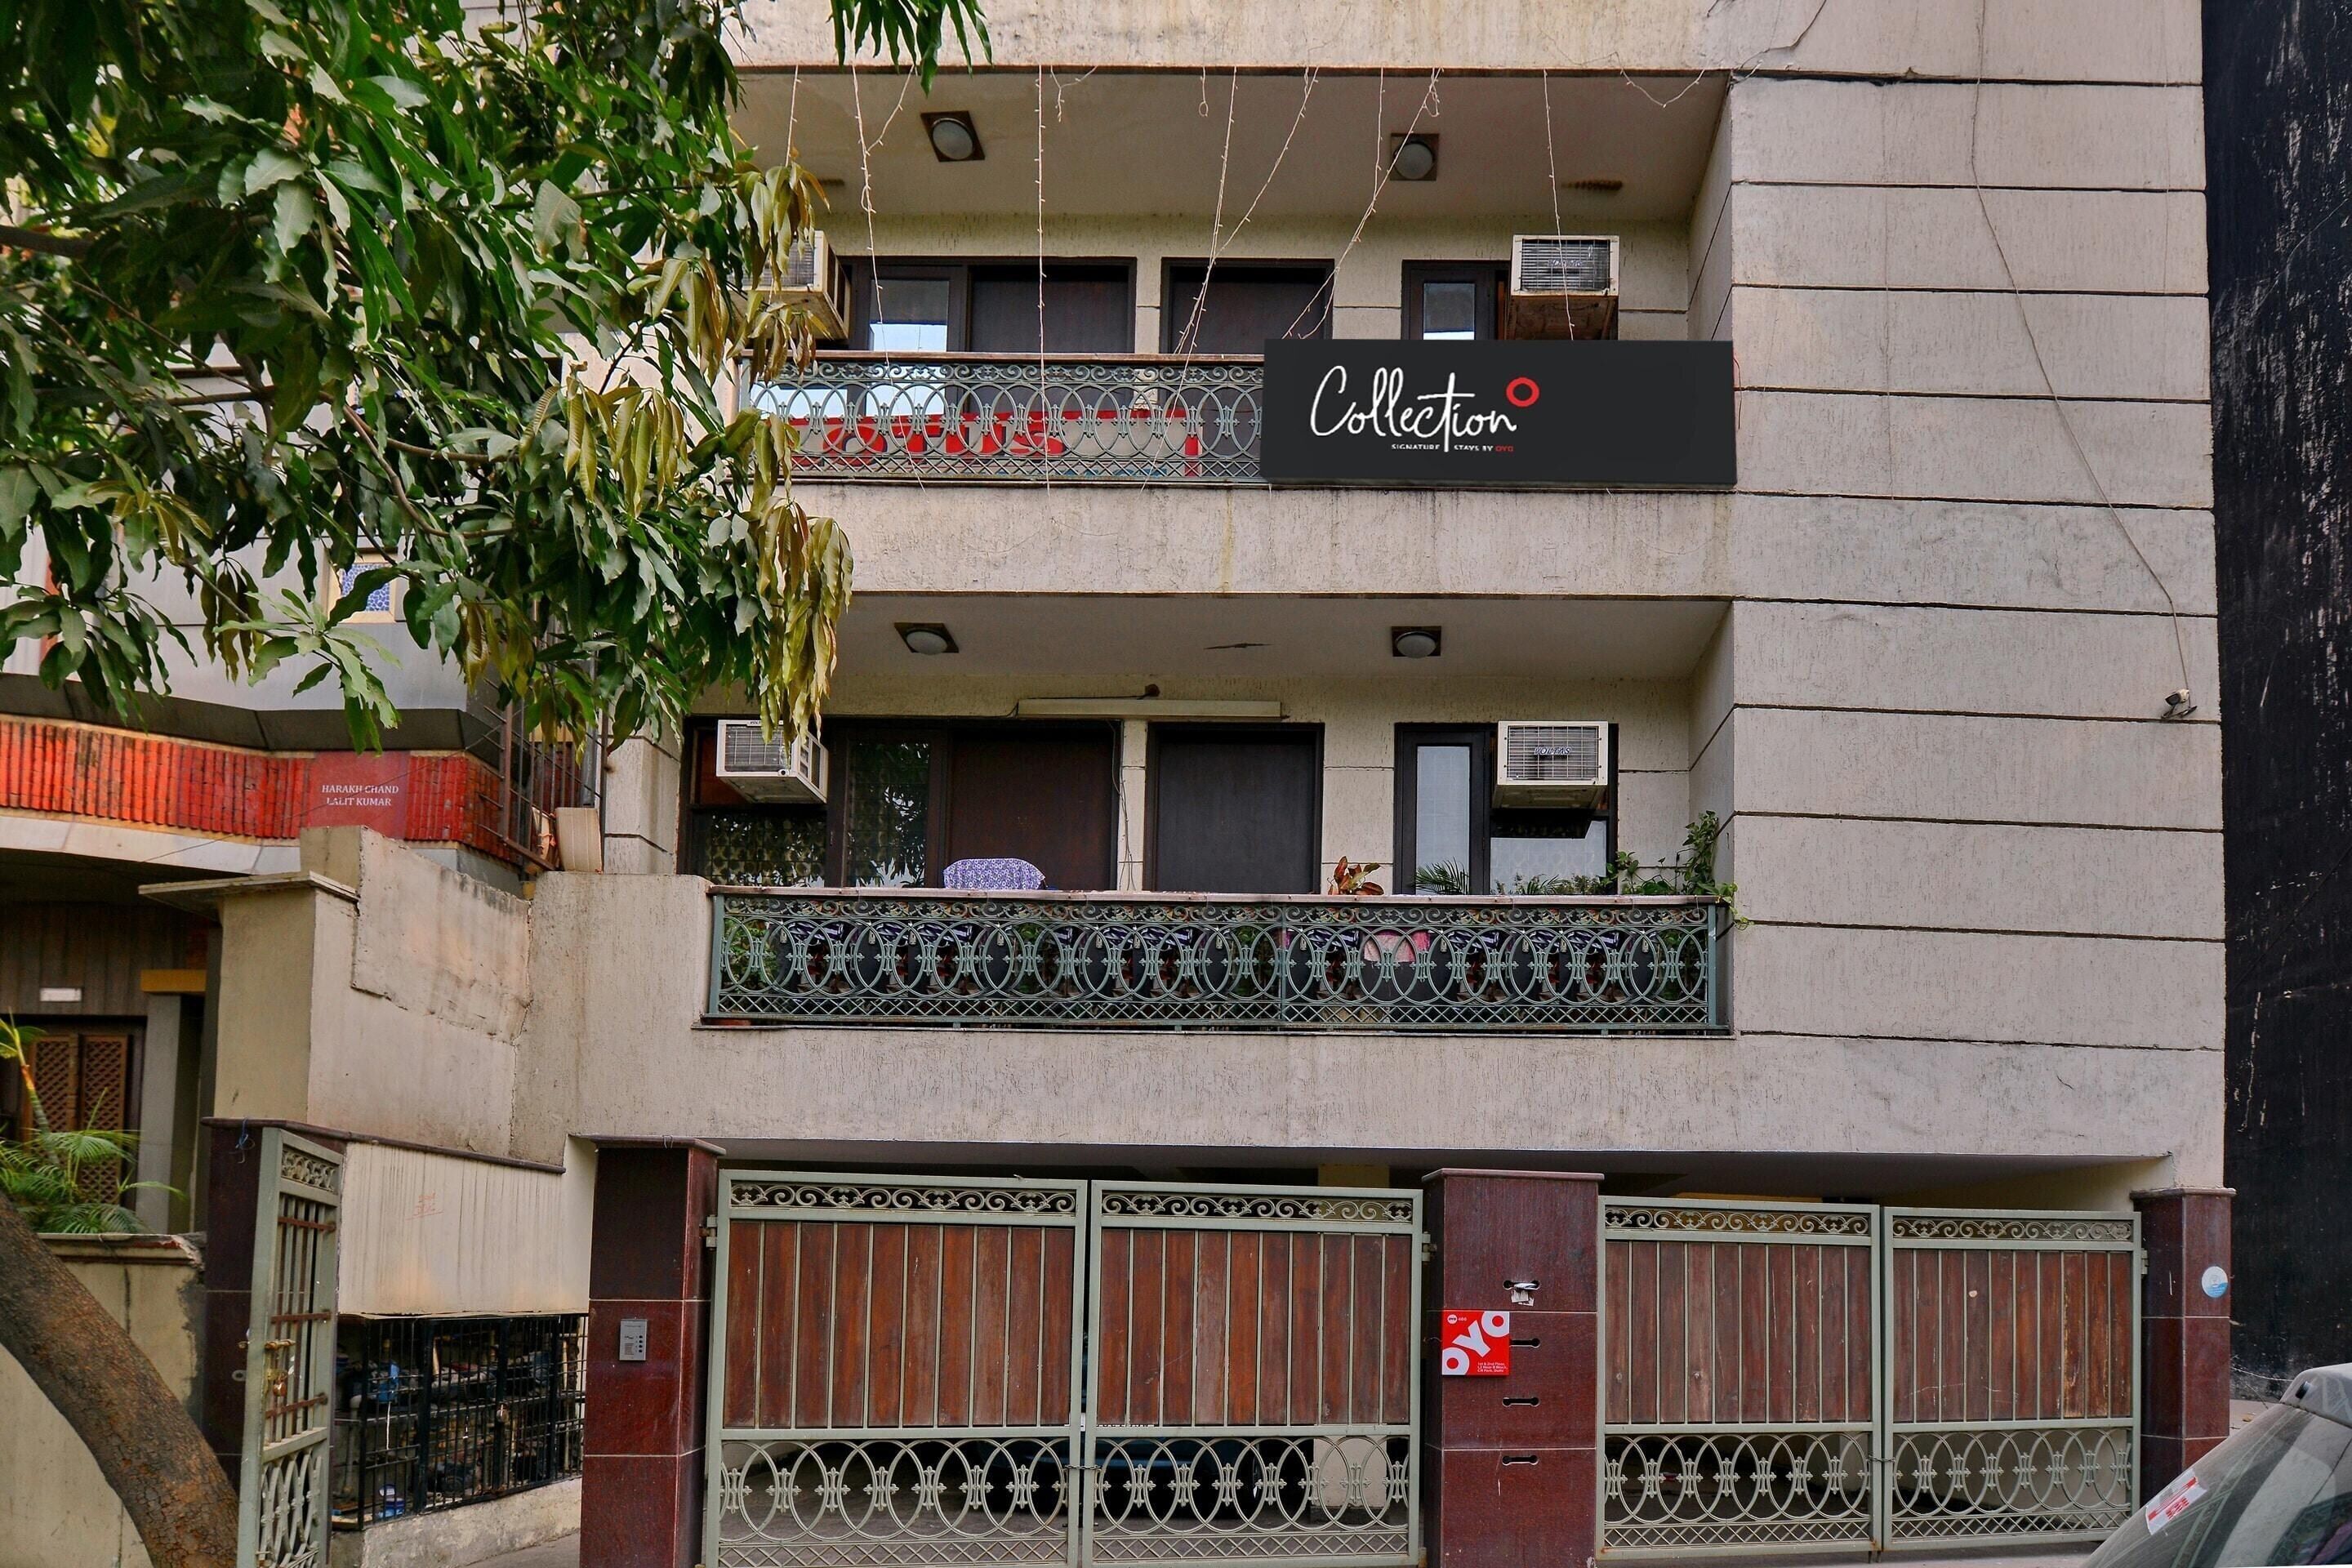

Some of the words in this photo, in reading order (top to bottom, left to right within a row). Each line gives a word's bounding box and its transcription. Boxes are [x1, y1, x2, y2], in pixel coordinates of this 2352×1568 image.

[1310, 365, 1517, 452] Collection
[322, 784, 363, 794] HARAKH
[364, 785, 399, 794] CHAND
[327, 796, 355, 806] LALIT
[356, 797, 392, 806] KUMAR
